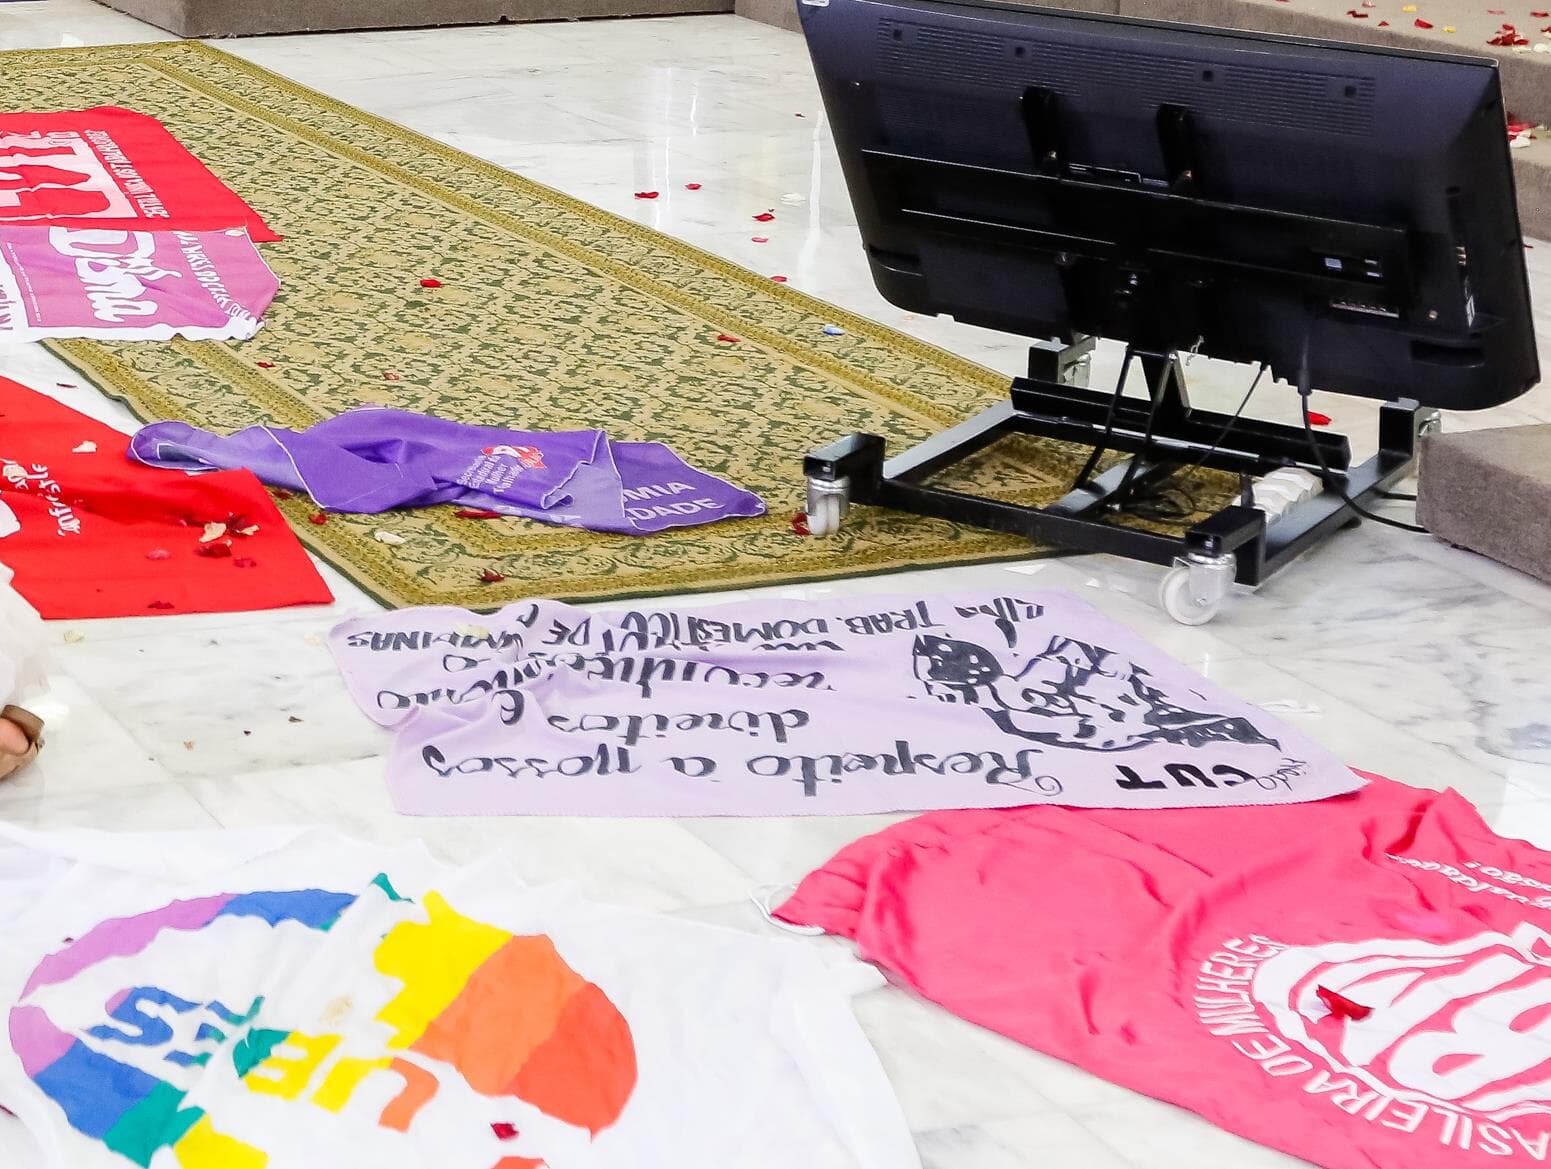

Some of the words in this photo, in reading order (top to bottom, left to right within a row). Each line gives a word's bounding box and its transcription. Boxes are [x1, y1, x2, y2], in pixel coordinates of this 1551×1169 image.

[625, 497, 727, 522] DADE
[540, 619, 592, 645] DE
[548, 707, 810, 747] direitos
[421, 742, 643, 779] nossos
[747, 740, 1065, 798] Respeito
[1117, 761, 1260, 790] CUT
[1192, 933, 1296, 1037] MULHERES
[1231, 1034, 1314, 1078] DE
